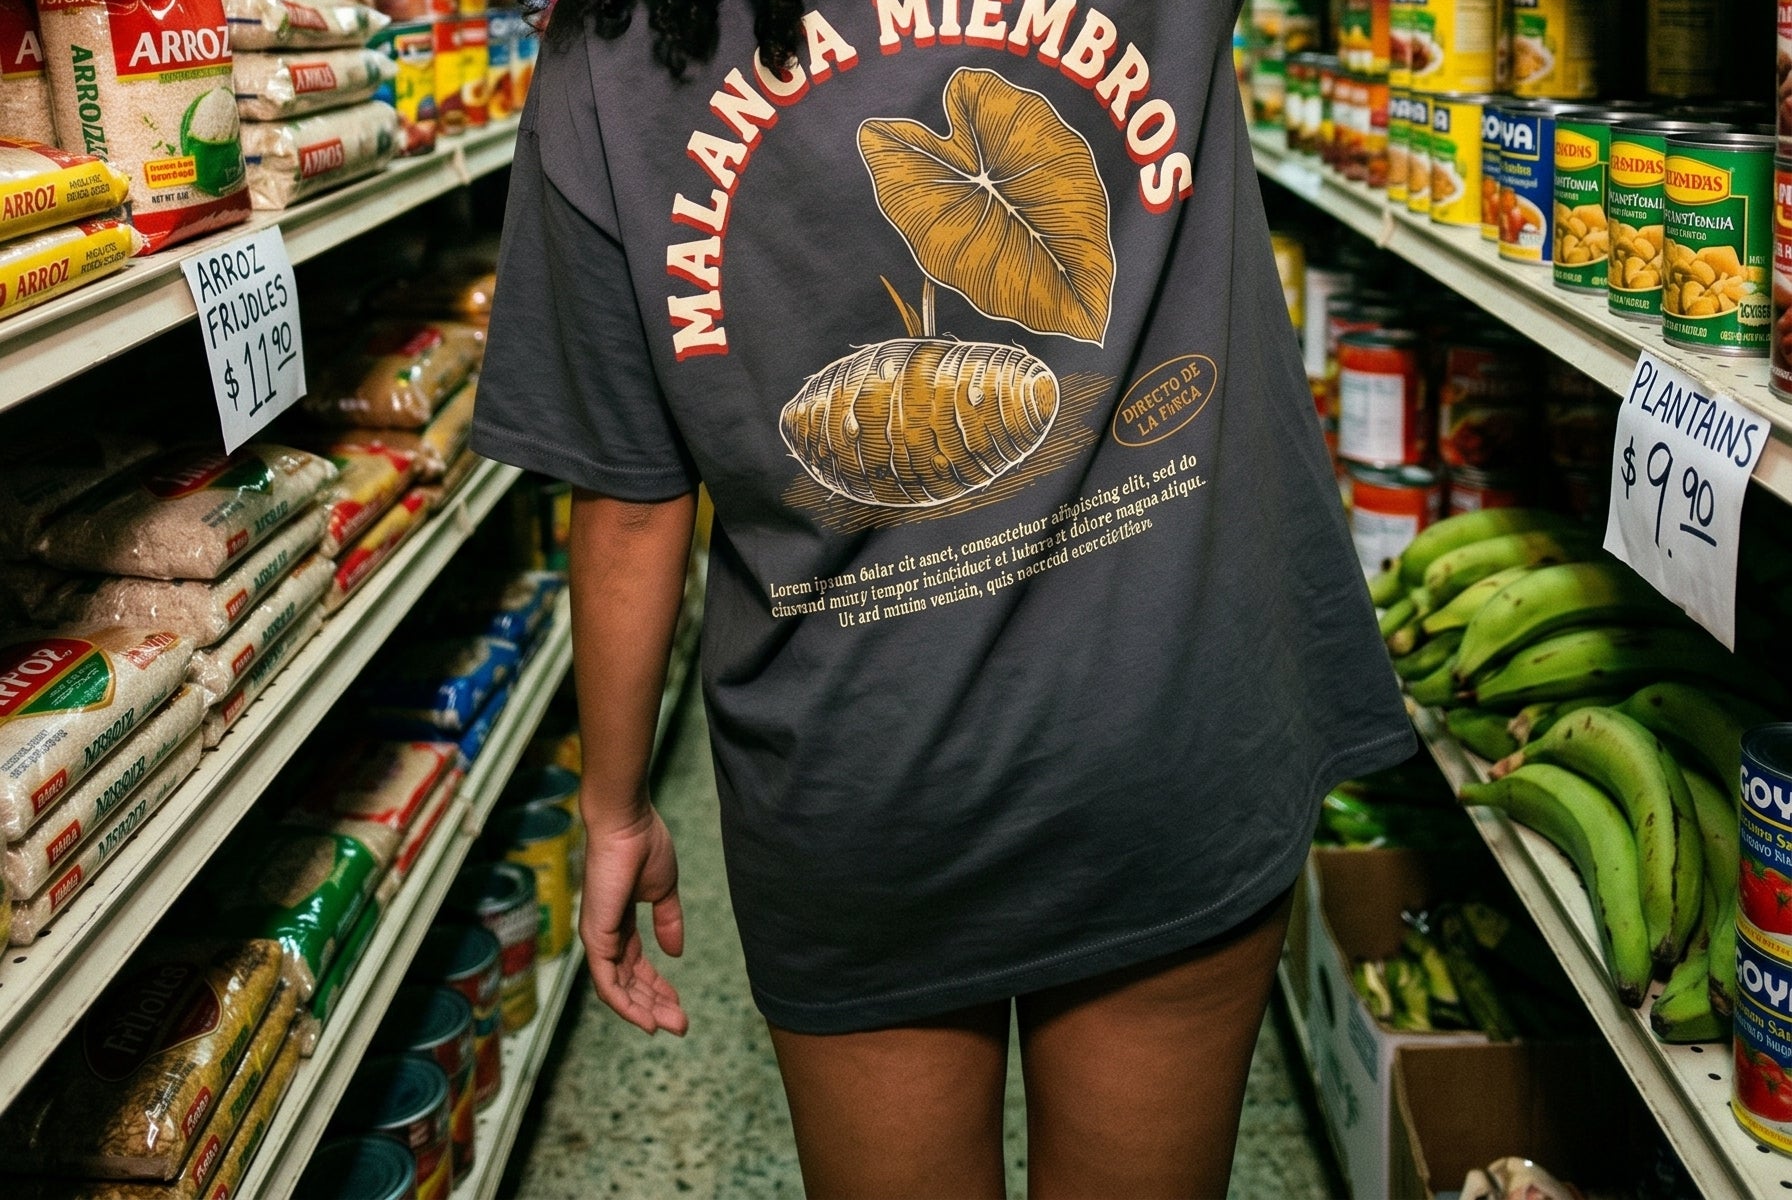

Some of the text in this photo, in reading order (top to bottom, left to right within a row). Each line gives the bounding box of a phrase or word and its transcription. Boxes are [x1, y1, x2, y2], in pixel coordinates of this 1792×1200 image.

[128, 25, 233, 68] ARROZ
[3, 183, 57, 221] ARROZ
[15, 257, 71, 301] ARROZ
[196, 243, 266, 304] ARROZ
[206, 273, 289, 349] FRIJOLES
[1121, 361, 1201, 425] DIRECTO DE
[1629, 360, 1759, 468] PLANTAINS
[1137, 414, 1160, 437] LA
[769, 583, 813, 599] Lorem
[814, 573, 858, 595] ipsum
[898, 554, 917, 573] cit
[1121, 473, 1151, 496] elit,
[1152, 459, 1178, 483] sed
[1179, 454, 1198, 472] do
[994, 554, 1009, 568] et
[1070, 511, 1114, 539] dolore
[1115, 493, 1160, 521] magna
[838, 611, 856, 629] Ut
[858, 604, 881, 625] ard
[986, 570, 1015, 596] quis
[1736, 946, 1792, 1013] GOY
